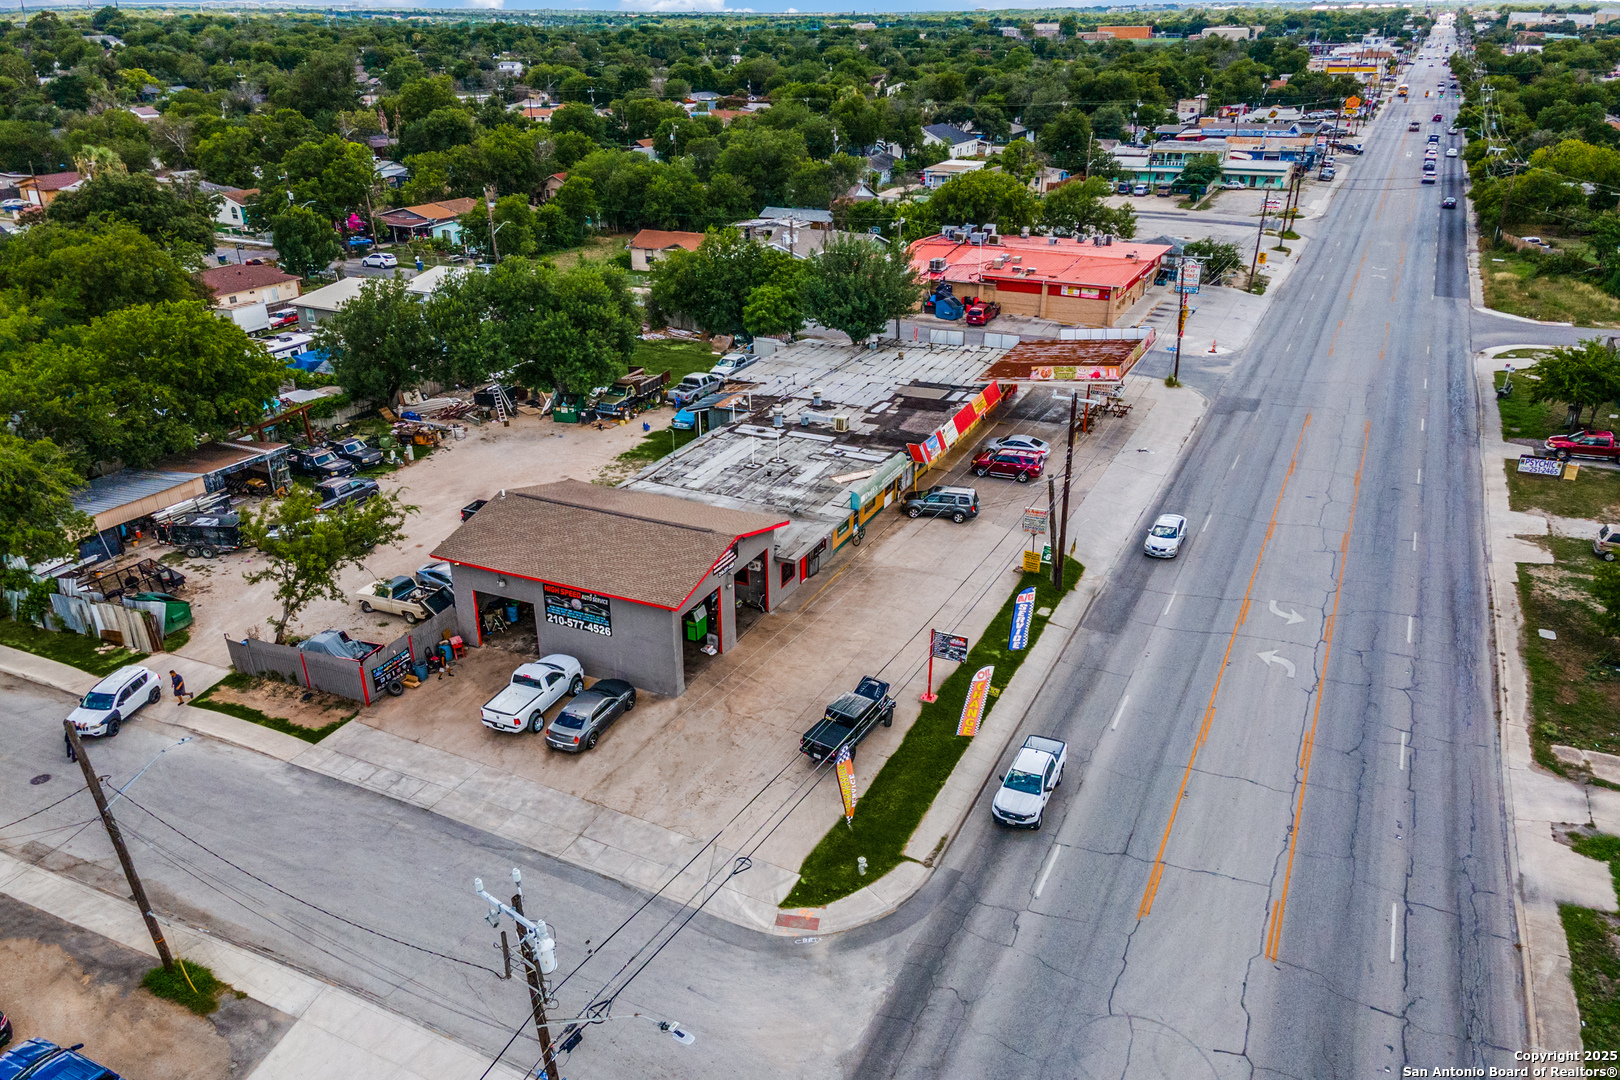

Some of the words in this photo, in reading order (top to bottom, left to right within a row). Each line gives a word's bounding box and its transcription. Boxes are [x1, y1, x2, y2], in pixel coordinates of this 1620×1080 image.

[1525, 458, 1557, 469] PSYCHIC
[1529, 466, 1558, 474] 251-2465
[544, 585, 560, 594] HIGH
[560, 588, 581, 598] SPEED
[592, 596, 608, 604] SERVICE
[1018, 594, 1034, 602] A/C
[547, 614, 611, 636] 210-577-4526
[1012, 604, 1028, 649] SERVICE
[977, 669, 991, 680] OIL
[963, 682, 985, 735] CHANGE
